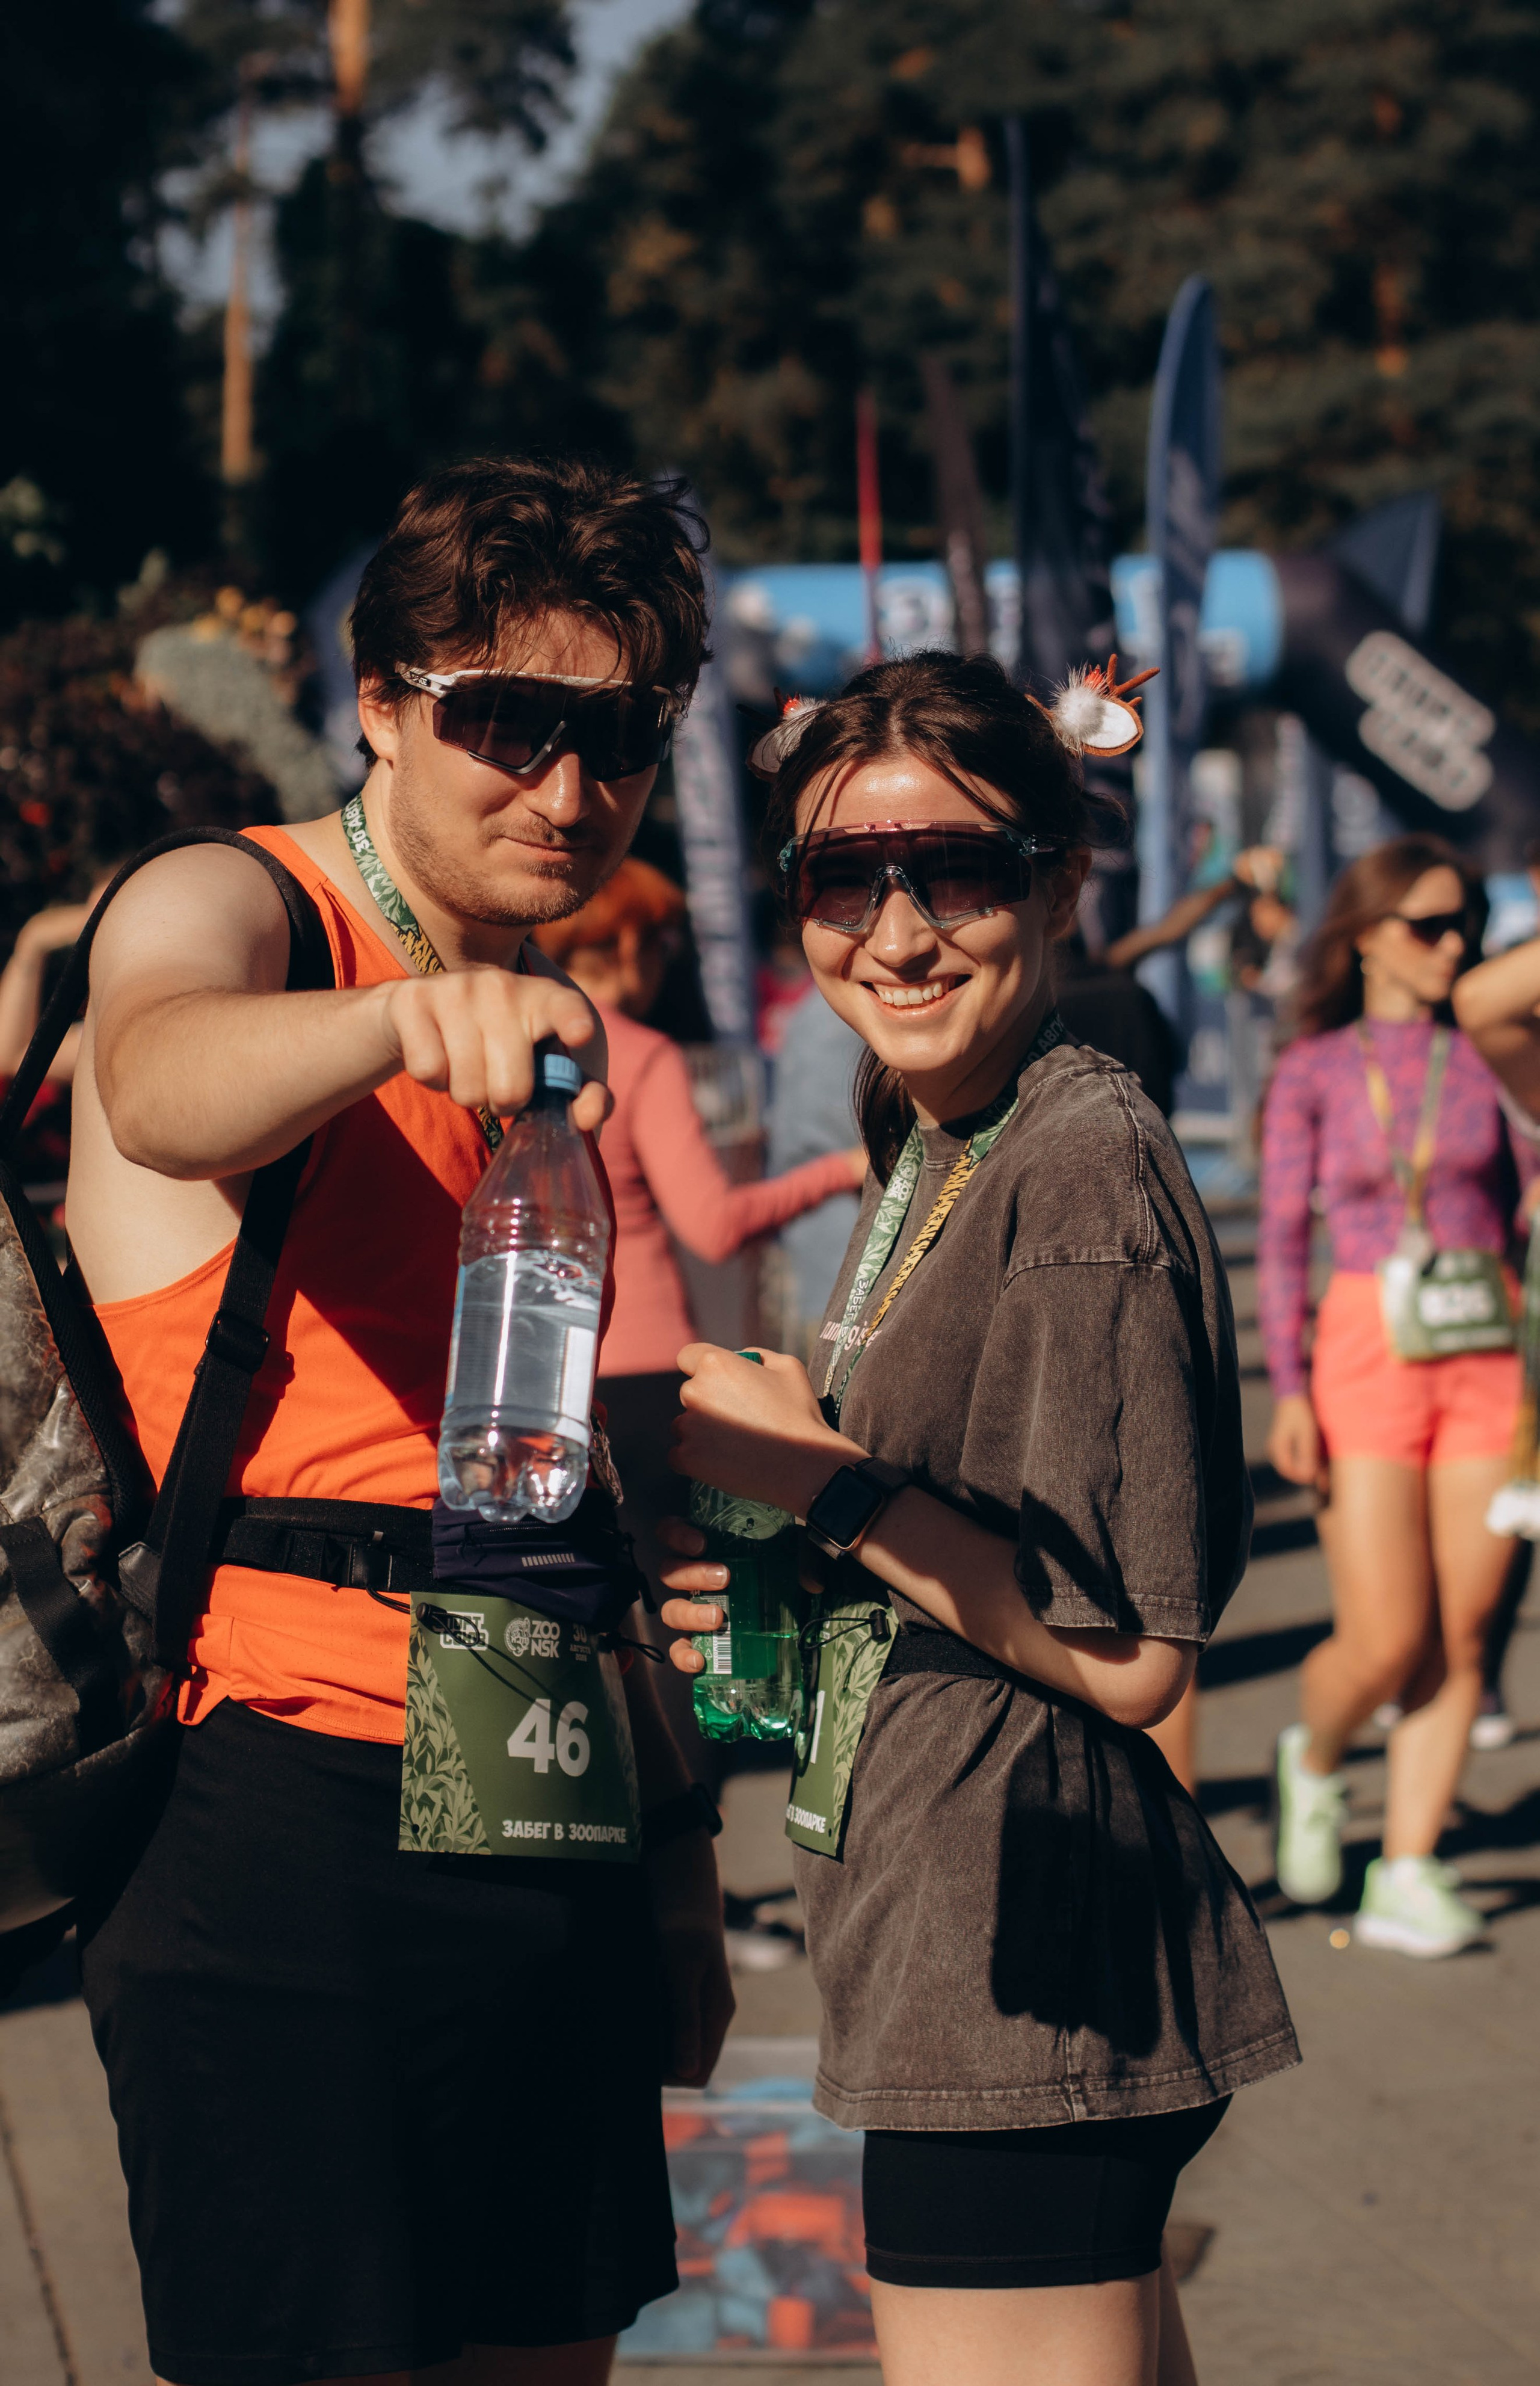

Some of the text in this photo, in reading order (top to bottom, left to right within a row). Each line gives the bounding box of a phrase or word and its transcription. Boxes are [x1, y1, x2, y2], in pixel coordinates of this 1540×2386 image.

[351, 830, 371, 853] 30
[846, 1278, 869, 1320] ЗАБЕГ
[532, 1620, 561, 1640] ZOO
[573, 1623, 588, 1643] 30
[531, 1639, 559, 1658] NSK
[507, 1698, 590, 1777] 46
[502, 1819, 627, 1843] ЗАБЕГ В ЗООПАРКЕ
[794, 1806, 827, 1834] ЗООПАРКЕ
